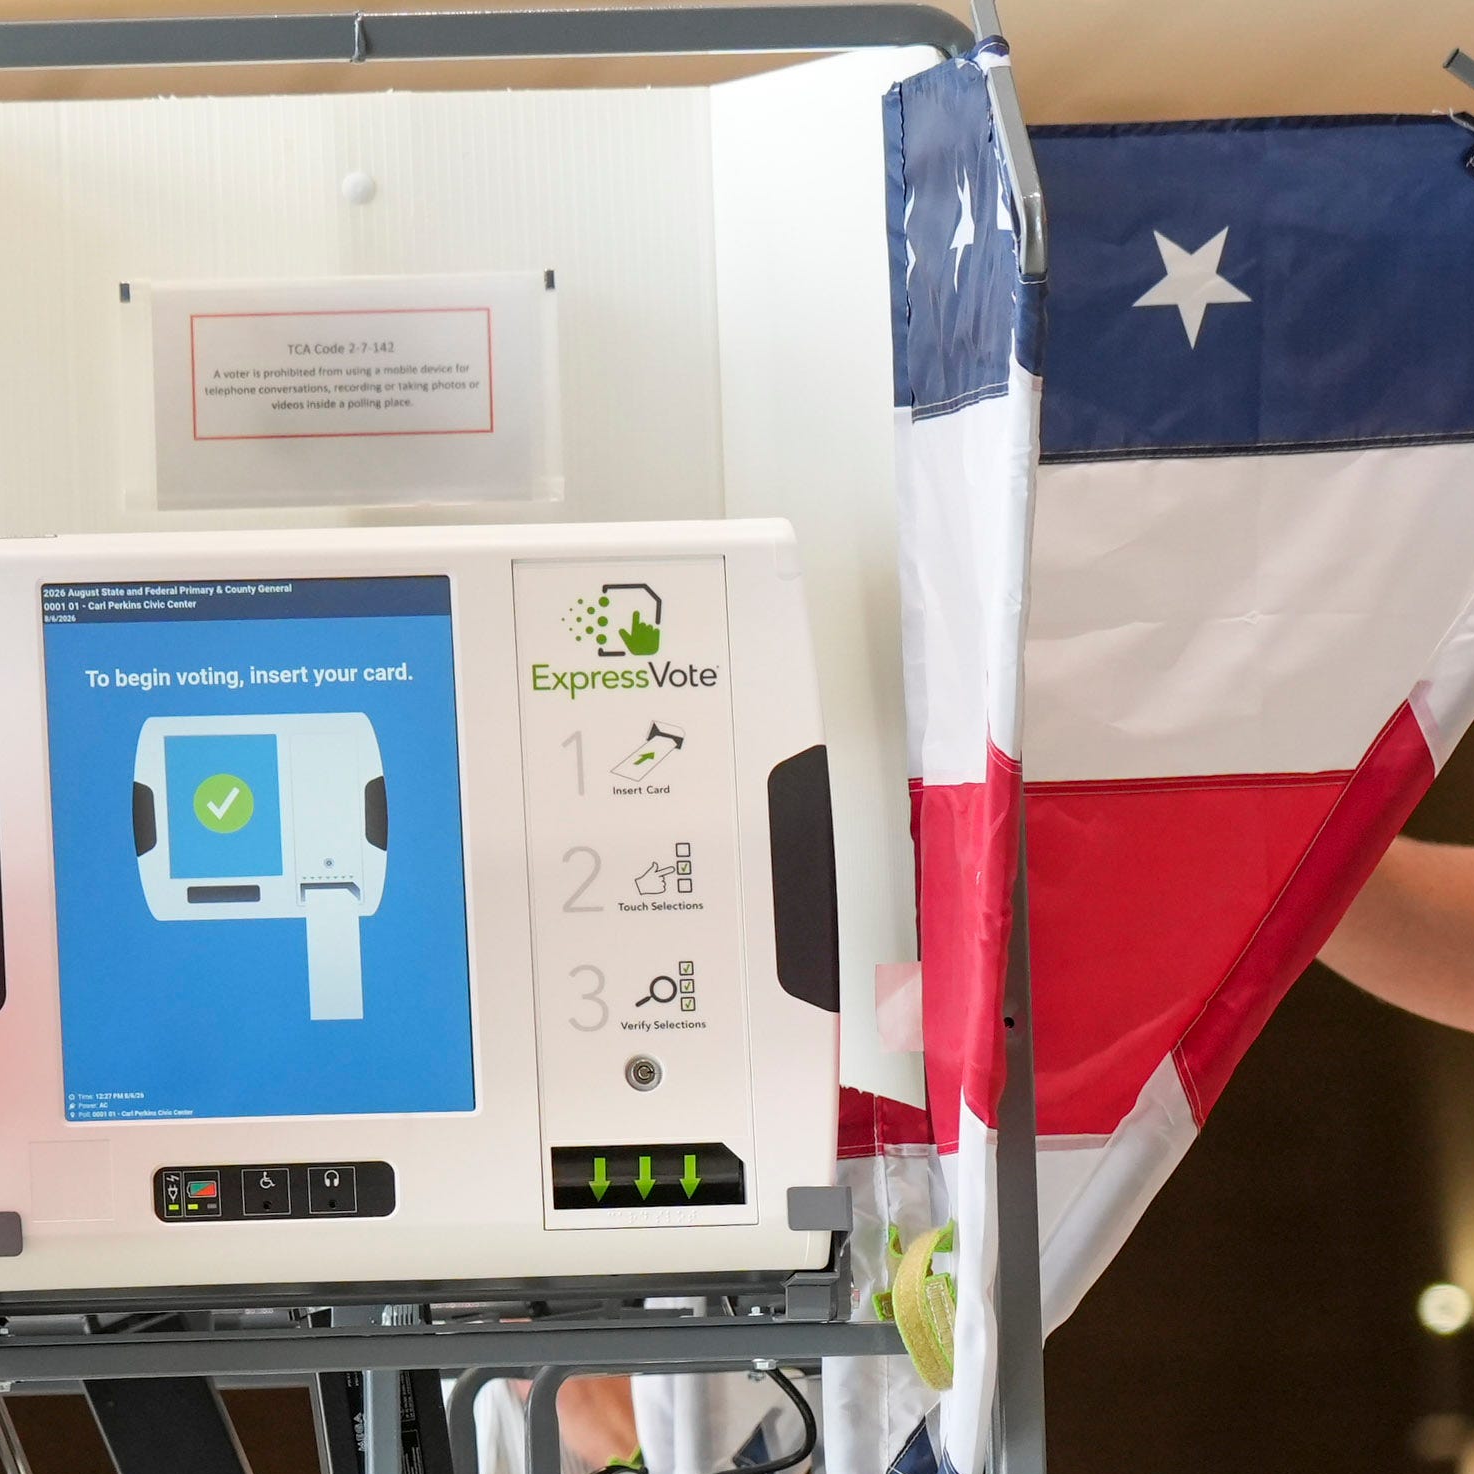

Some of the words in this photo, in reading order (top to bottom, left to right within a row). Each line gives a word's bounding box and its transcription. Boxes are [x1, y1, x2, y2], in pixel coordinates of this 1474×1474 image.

[288, 344, 311, 355] TCA
[314, 343, 345, 355] Code
[349, 341, 394, 354] 2-7-142
[213, 369, 221, 379] A
[223, 370, 249, 379] voter
[253, 369, 261, 378] is
[263, 367, 316, 380] prohibited
[318, 366, 343, 377] from
[345, 366, 372, 377] using
[375, 367, 381, 375] a
[384, 364, 418, 375] mobile
[420, 364, 453, 374] device
[455, 363, 470, 373] for
[205, 385, 256, 397] telephone
[258, 384, 331, 395] conversations,
[334, 383, 382, 393] recording
[384, 383, 395, 391] or
[398, 382, 429, 392] taking
[431, 380, 467, 391] photos
[469, 381, 479, 390] or
[271, 400, 305, 410] videos
[307, 399, 336, 409] inside
[339, 401, 345, 409] a
[348, 399, 382, 410] polling
[384, 398, 414, 409] place.
[43, 588, 66, 598] 2026
[68, 588, 99, 599] August
[101, 588, 125, 596] State
[127, 586, 143, 596] and
[145, 586, 178, 595] Federal
[179, 586, 214, 596] Primary
[216, 585, 223, 594] &
[225, 585, 256, 595] County
[258, 584, 292, 593] General
[43, 602, 66, 611] 0001
[68, 602, 80, 610] 01
[88, 601, 106, 610] Carl
[108, 601, 142, 609] Perkins
[143, 600, 165, 609] Civic
[167, 600, 197, 609] Center
[85, 670, 110, 688] To
[115, 668, 170, 691] begin
[176, 667, 244, 689] voting,
[250, 666, 309, 684] insert
[312, 666, 357, 687] your
[363, 662, 414, 681] card.
[531, 660, 717, 699] ExpressVote
[561, 730, 586, 796] 1
[612, 785, 643, 795] Insert
[646, 784, 670, 795] Card
[562, 846, 604, 913] 2
[618, 901, 648, 912] Touch
[651, 900, 704, 911] Selections
[568, 964, 610, 1033] 3
[620, 1019, 652, 1032] Verify
[653, 1018, 706, 1030] Selections
